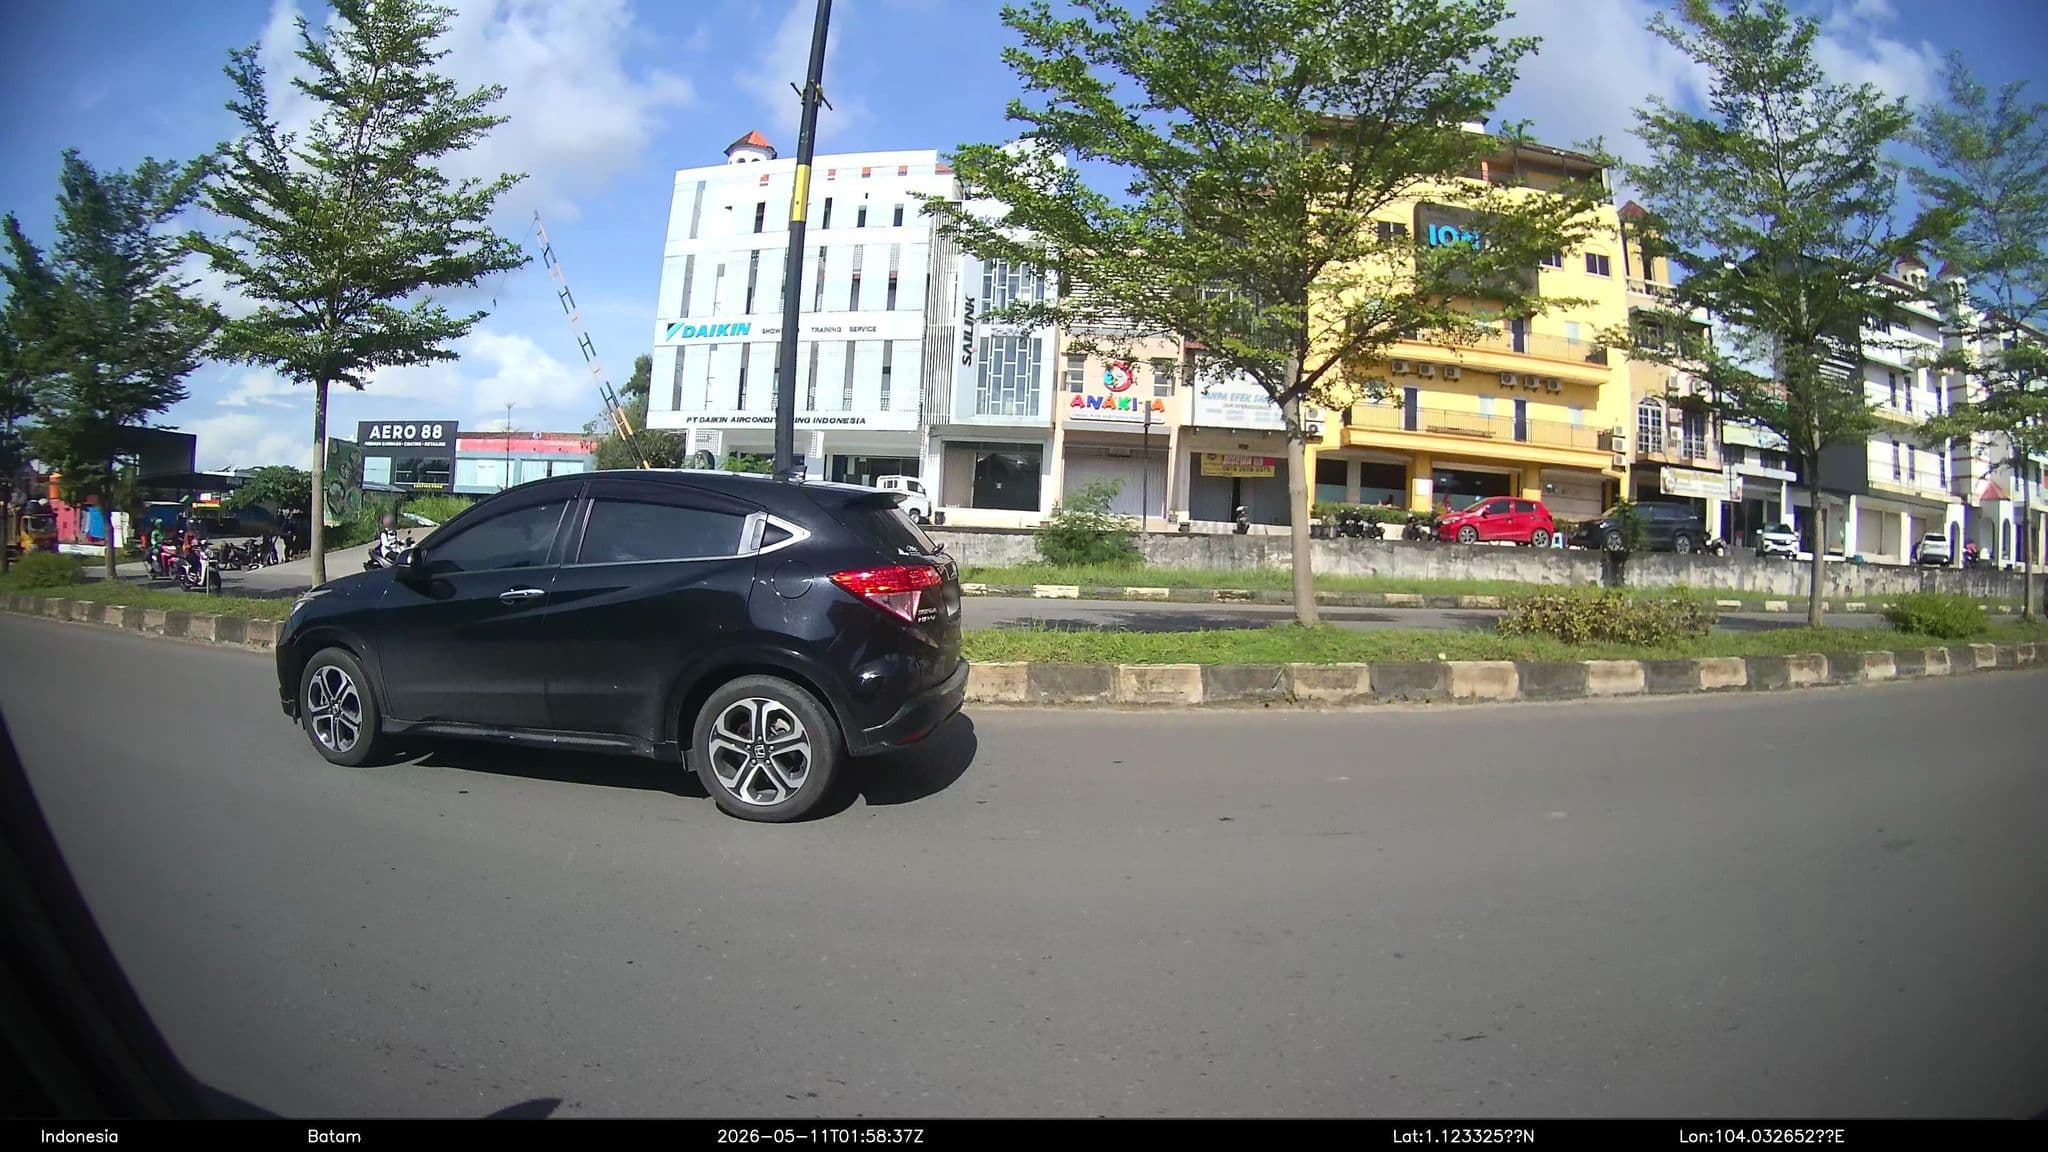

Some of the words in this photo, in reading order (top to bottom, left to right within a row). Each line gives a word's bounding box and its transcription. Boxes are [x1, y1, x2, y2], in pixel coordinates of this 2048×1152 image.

[682, 322, 752, 338] DAIKIN
[1070, 395, 1165, 413] ANAKIA
[699, 416, 728, 424] DAIKIN
[730, 416, 811, 424] AIRCONDIING
[369, 424, 416, 439] AERO
[421, 424, 443, 439] 88
